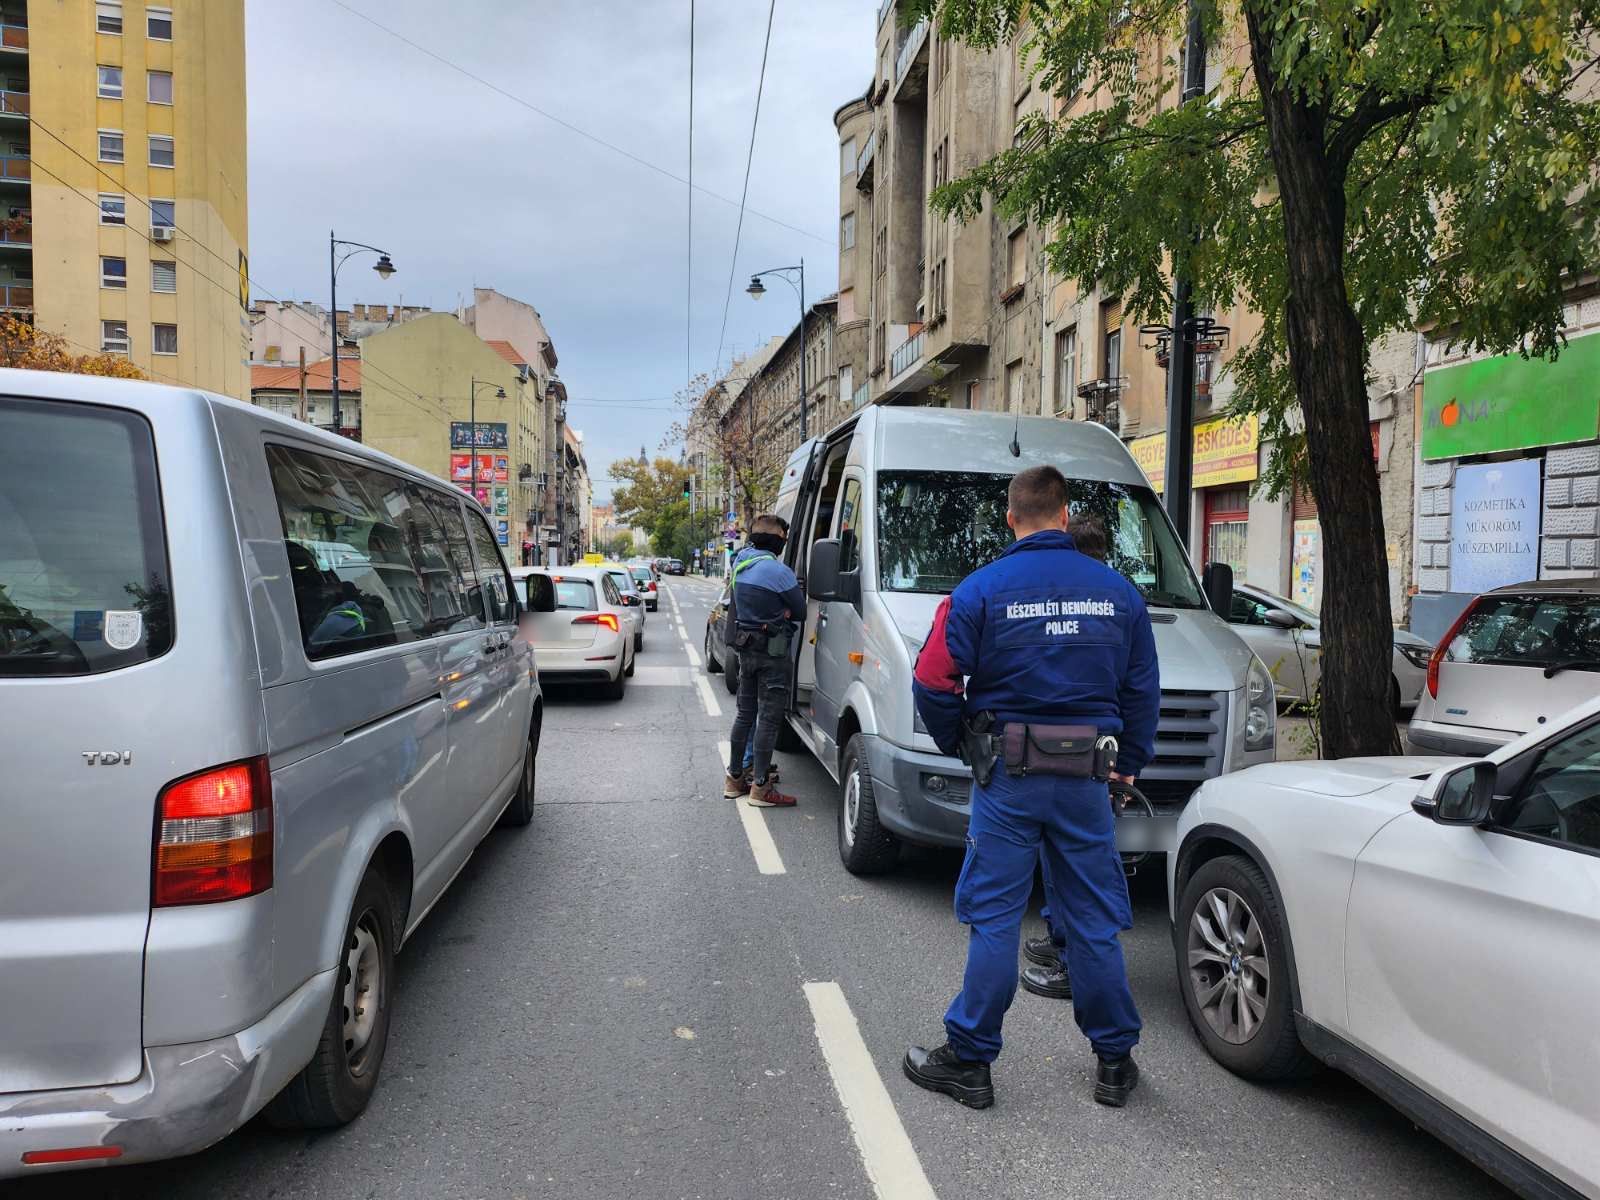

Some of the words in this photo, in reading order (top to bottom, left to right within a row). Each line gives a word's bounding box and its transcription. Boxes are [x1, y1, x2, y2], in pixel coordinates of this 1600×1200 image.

[1464, 498, 1526, 512] KOZMETIKA
[1007, 599, 1060, 619] KÉSZENLÉTI
[1045, 620, 1079, 635] POLICE
[82, 750, 131, 766] TDI
